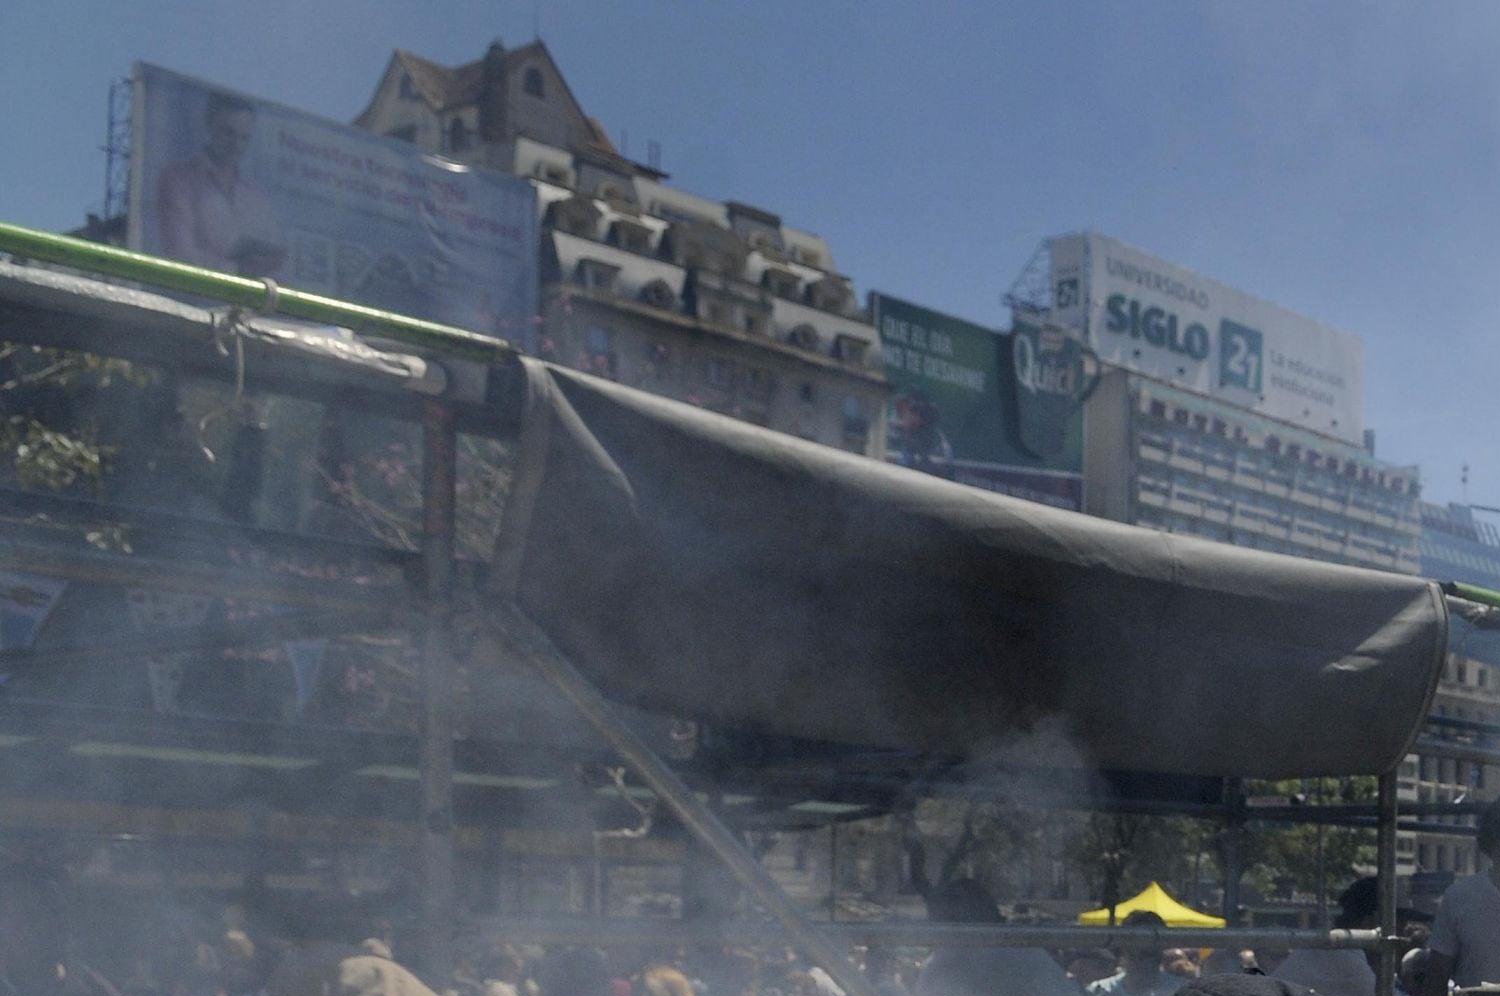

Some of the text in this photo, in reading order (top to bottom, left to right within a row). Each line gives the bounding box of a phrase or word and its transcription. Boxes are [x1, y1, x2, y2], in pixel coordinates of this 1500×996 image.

[1106, 257, 1209, 310] UNIVERSIDAD
[1107, 292, 1259, 389] SIGLO 21
[1270, 350, 1285, 368] La
[1150, 399, 1249, 446] HOTEL
